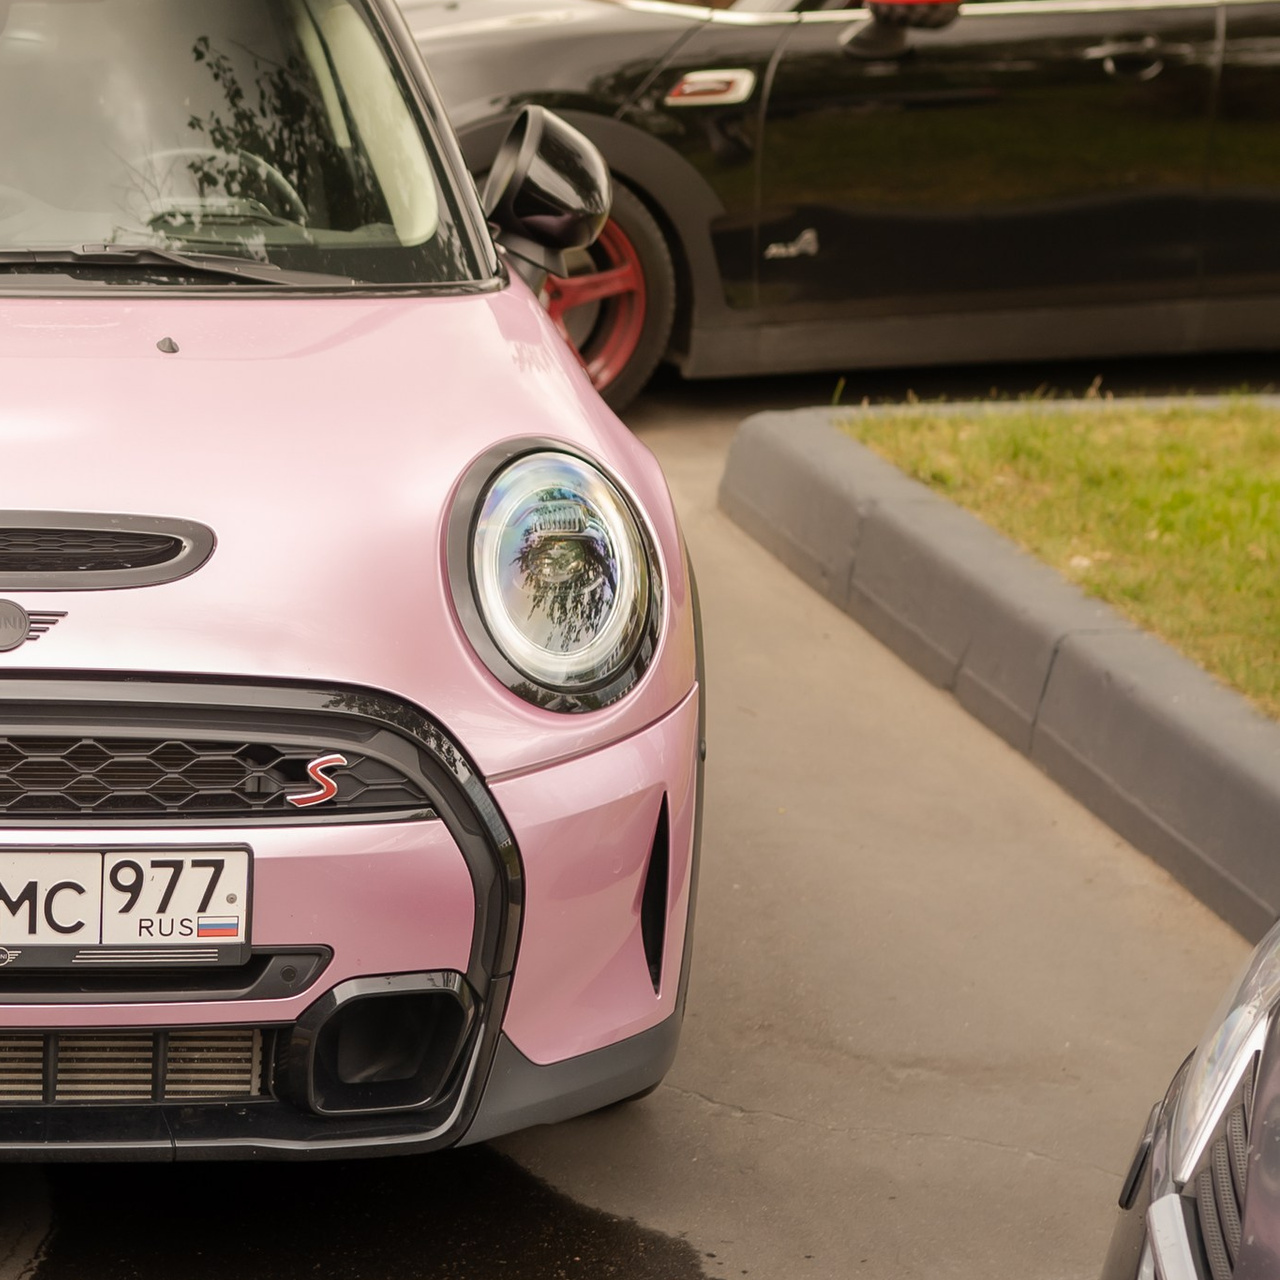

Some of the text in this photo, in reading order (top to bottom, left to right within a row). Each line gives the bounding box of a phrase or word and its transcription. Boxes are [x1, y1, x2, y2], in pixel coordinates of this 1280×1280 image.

[286, 753, 348, 808] S
[109, 858, 225, 914] 977
[138, 918, 194, 937] RUS
